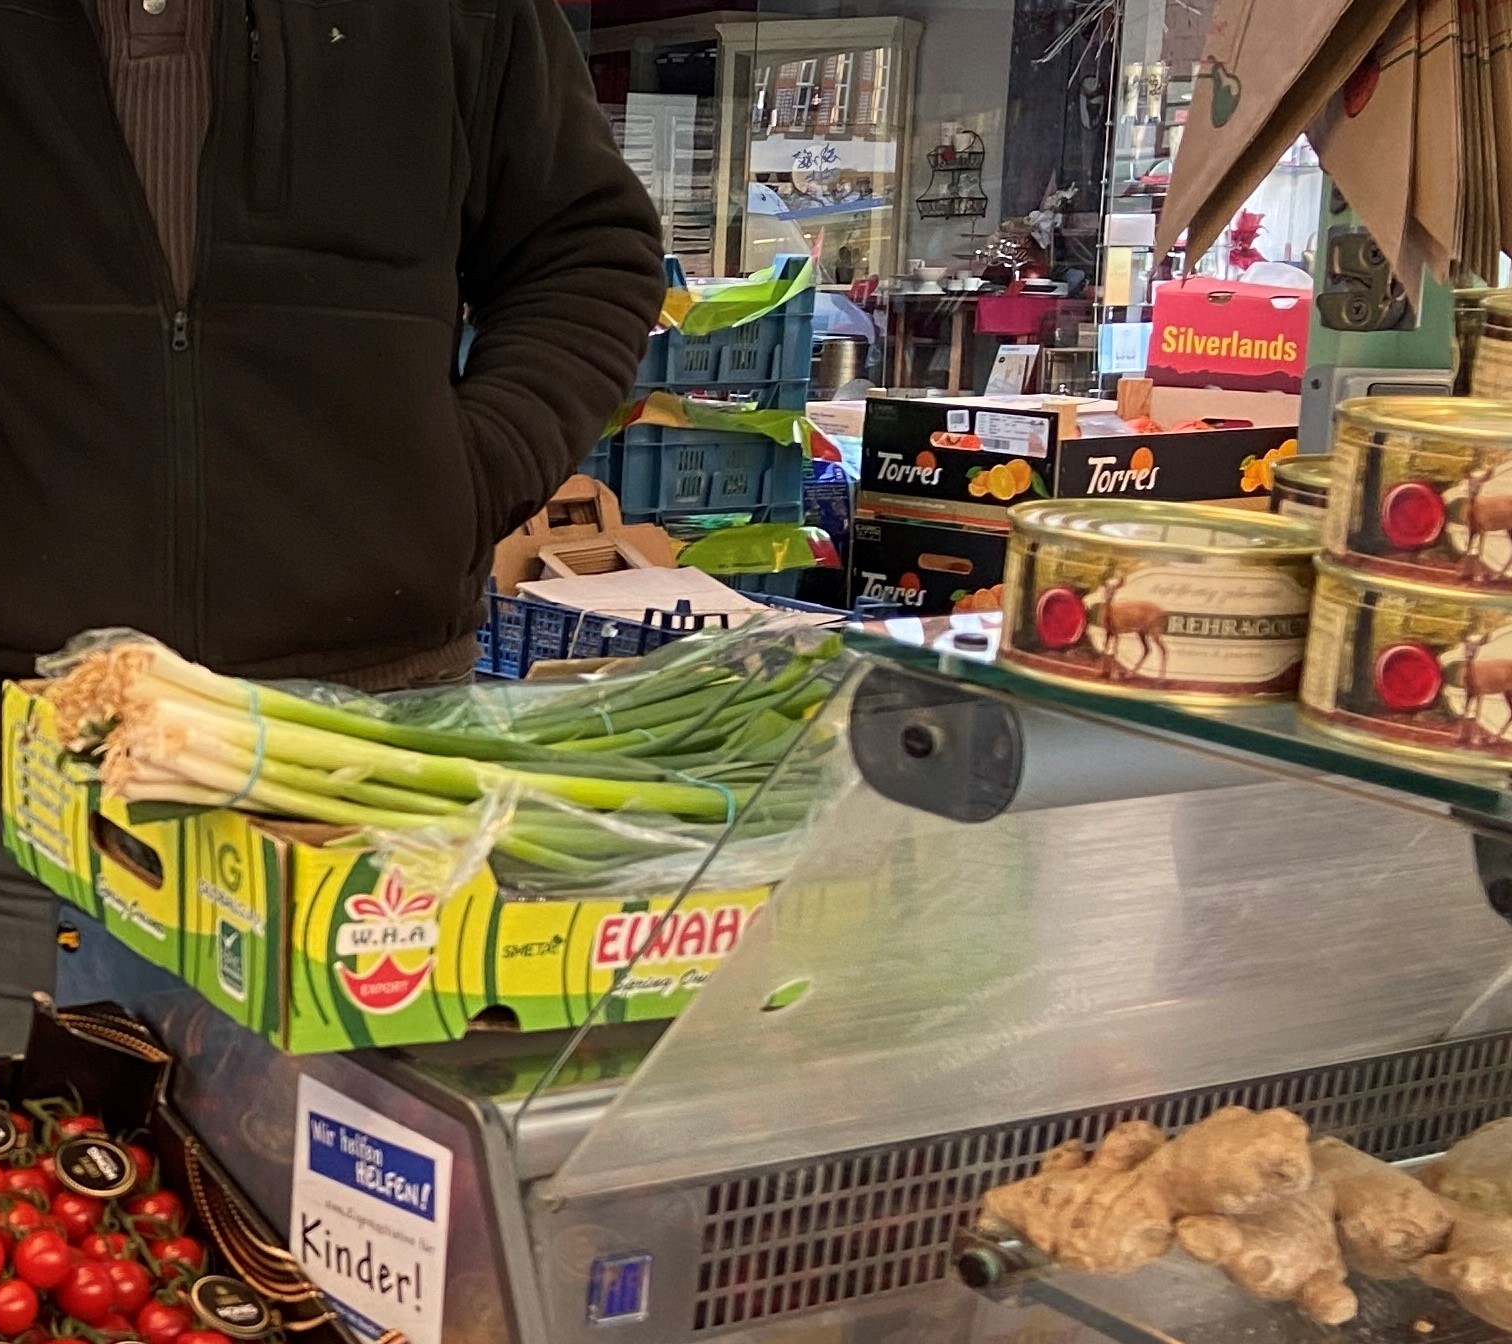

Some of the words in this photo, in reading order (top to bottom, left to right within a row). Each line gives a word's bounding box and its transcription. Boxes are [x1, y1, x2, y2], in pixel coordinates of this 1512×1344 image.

[1162, 325, 1297, 362] Silverlands
[877, 451, 943, 486] Torres
[1086, 456, 1160, 495] Torres
[861, 571, 927, 607] Torres
[1167, 615, 1296, 637] REHRAGO
[596, 908, 763, 963] ELWAH
[301, 1212, 422, 1313] Kinder!
